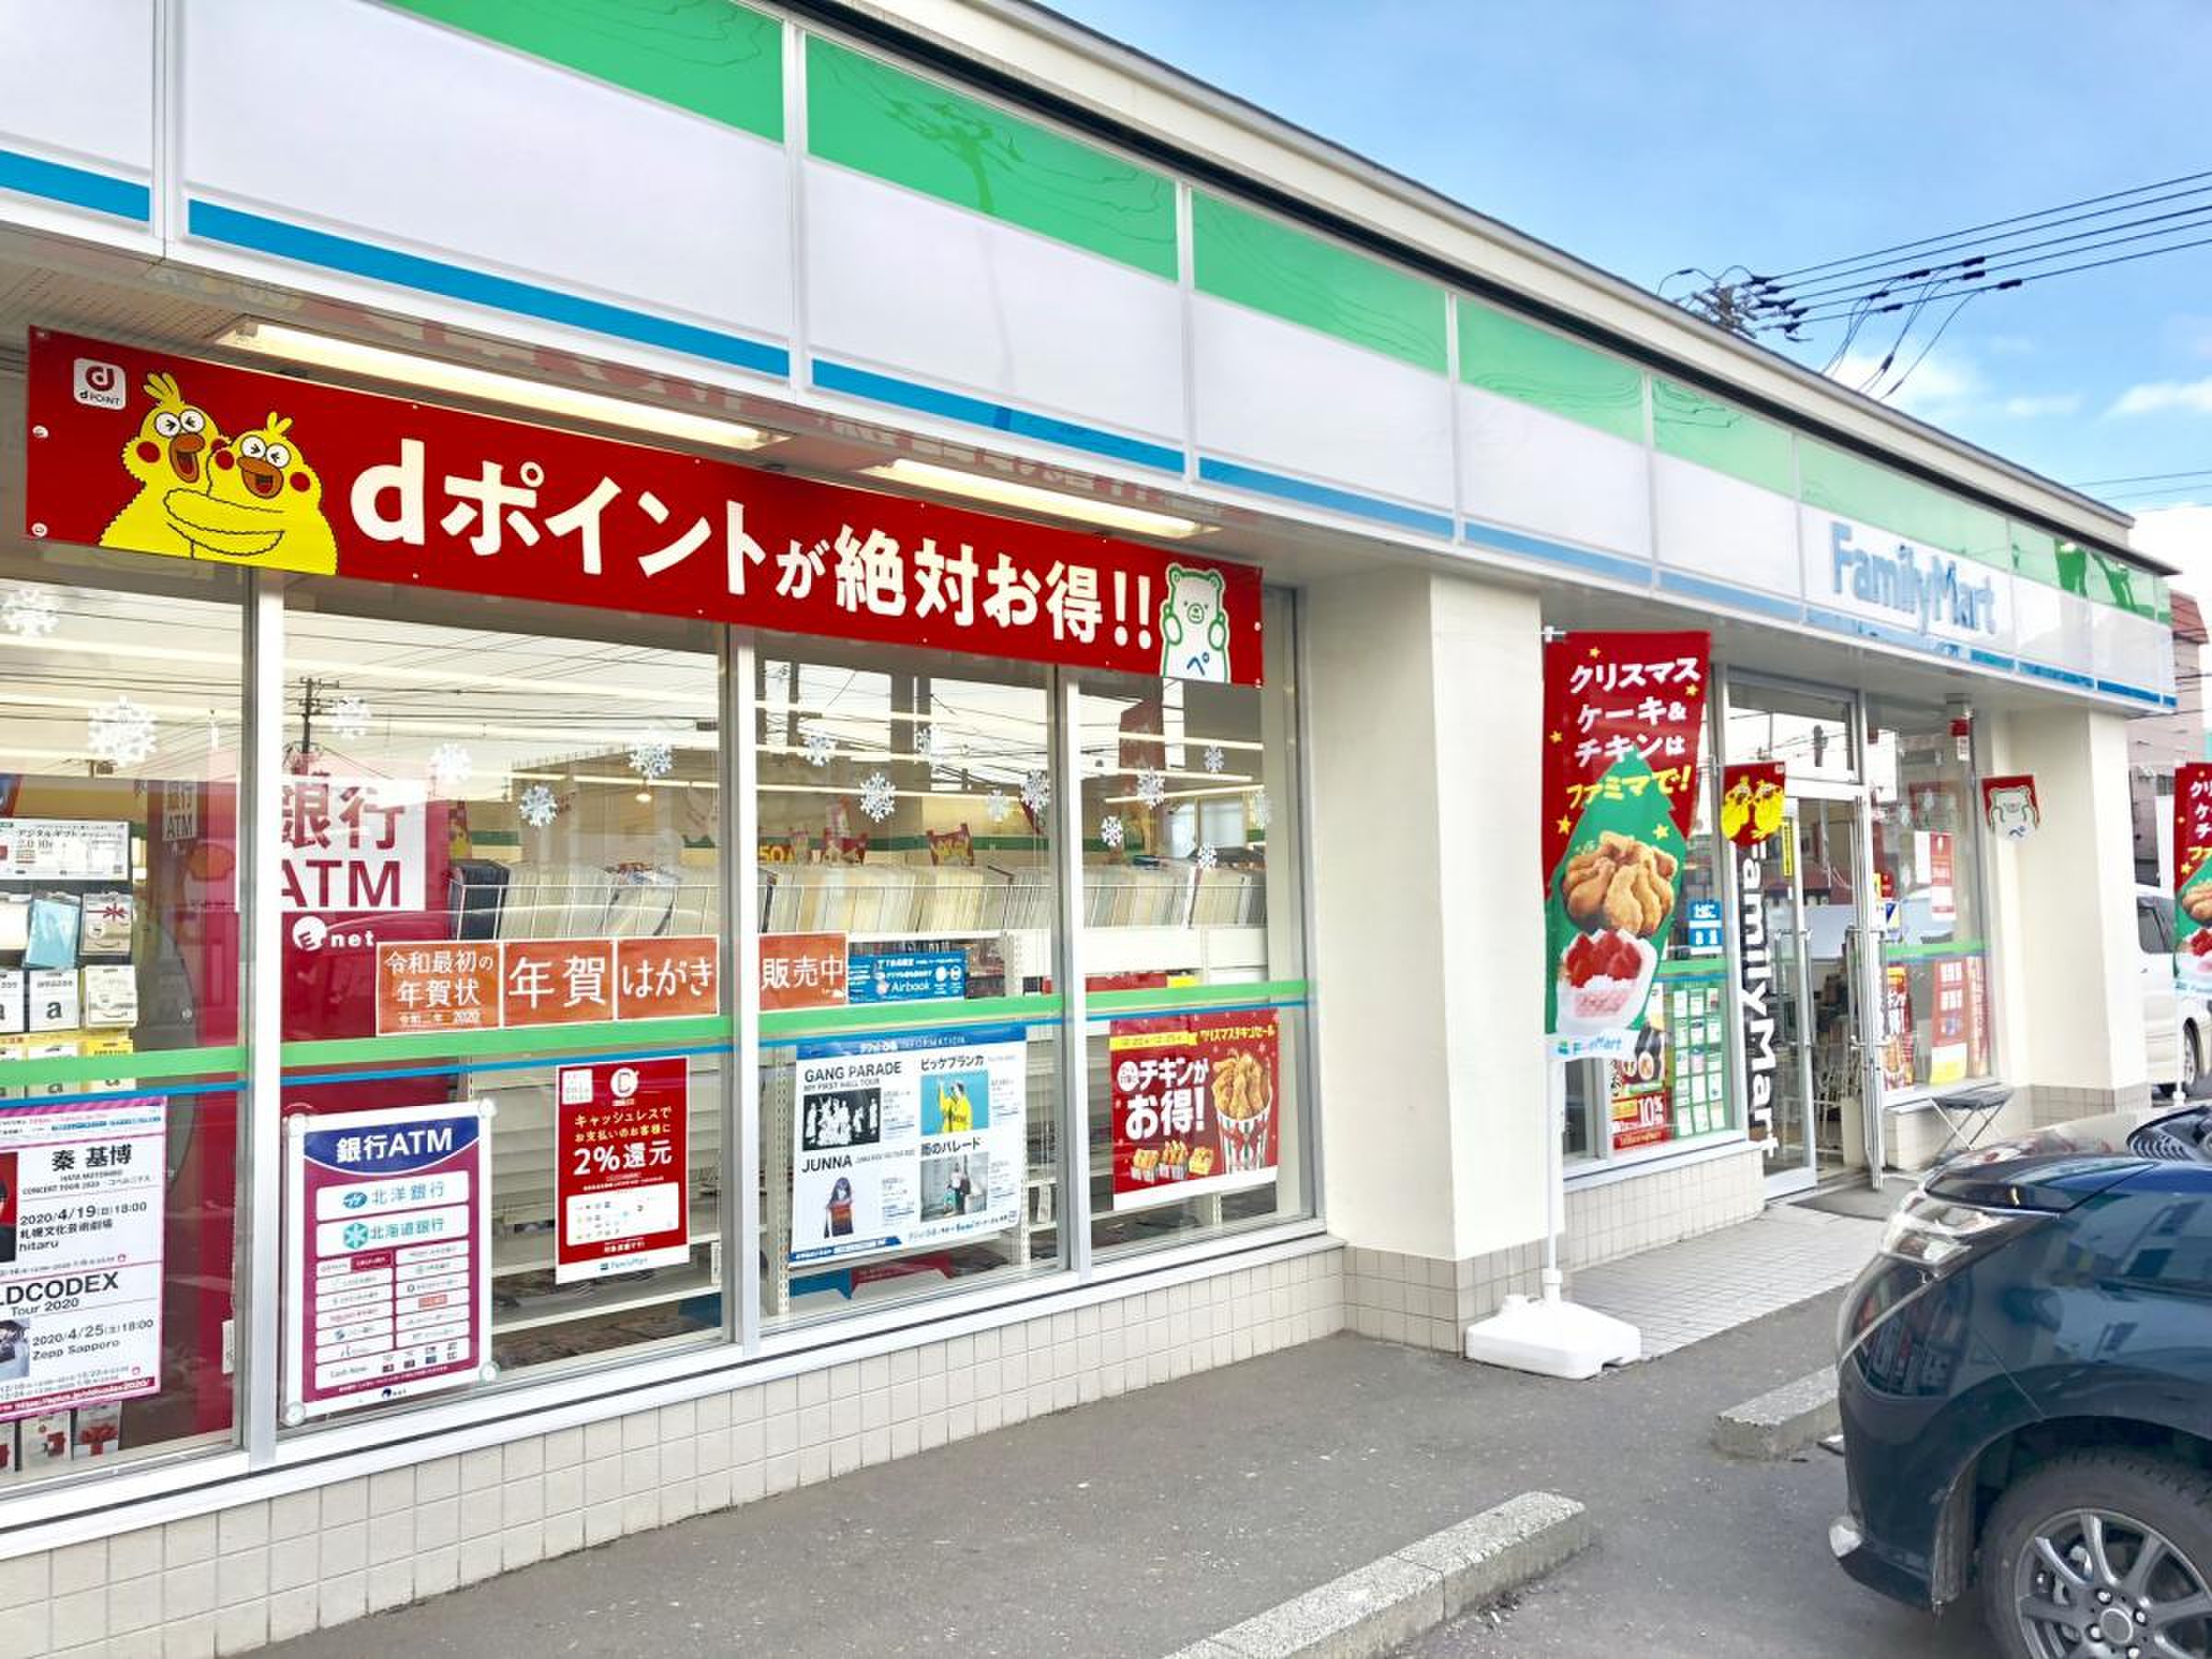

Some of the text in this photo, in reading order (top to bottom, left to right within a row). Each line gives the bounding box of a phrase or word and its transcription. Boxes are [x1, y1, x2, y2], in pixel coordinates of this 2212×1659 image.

[350, 437, 1151, 650] dポイントが絶対お得!!
[1831, 521, 1997, 636] FamilyMart
[1570, 657, 1701, 695] クリスマス
[1577, 696, 1688, 735] ケーキ&
[1574, 734, 1686, 768] チキンは
[1566, 765, 1692, 809] ファミマで!
[281, 858, 401, 908] ATM
[383, 949, 494, 976] 令和最初の
[761, 953, 844, 990] 販売中
[396, 977, 481, 1010] 年賀状
[805, 1062, 902, 1083] GANG PARADE
[574, 1106, 673, 1128] キャッシュレスで
[335, 1127, 453, 1165] 銀行ATM
[573, 1139, 673, 1176] 2%還元
[801, 1155, 853, 1173] JUNNA
[0, 1271, 119, 1306] DCODEX
[11, 1297, 80, 1317] Tour 2020
